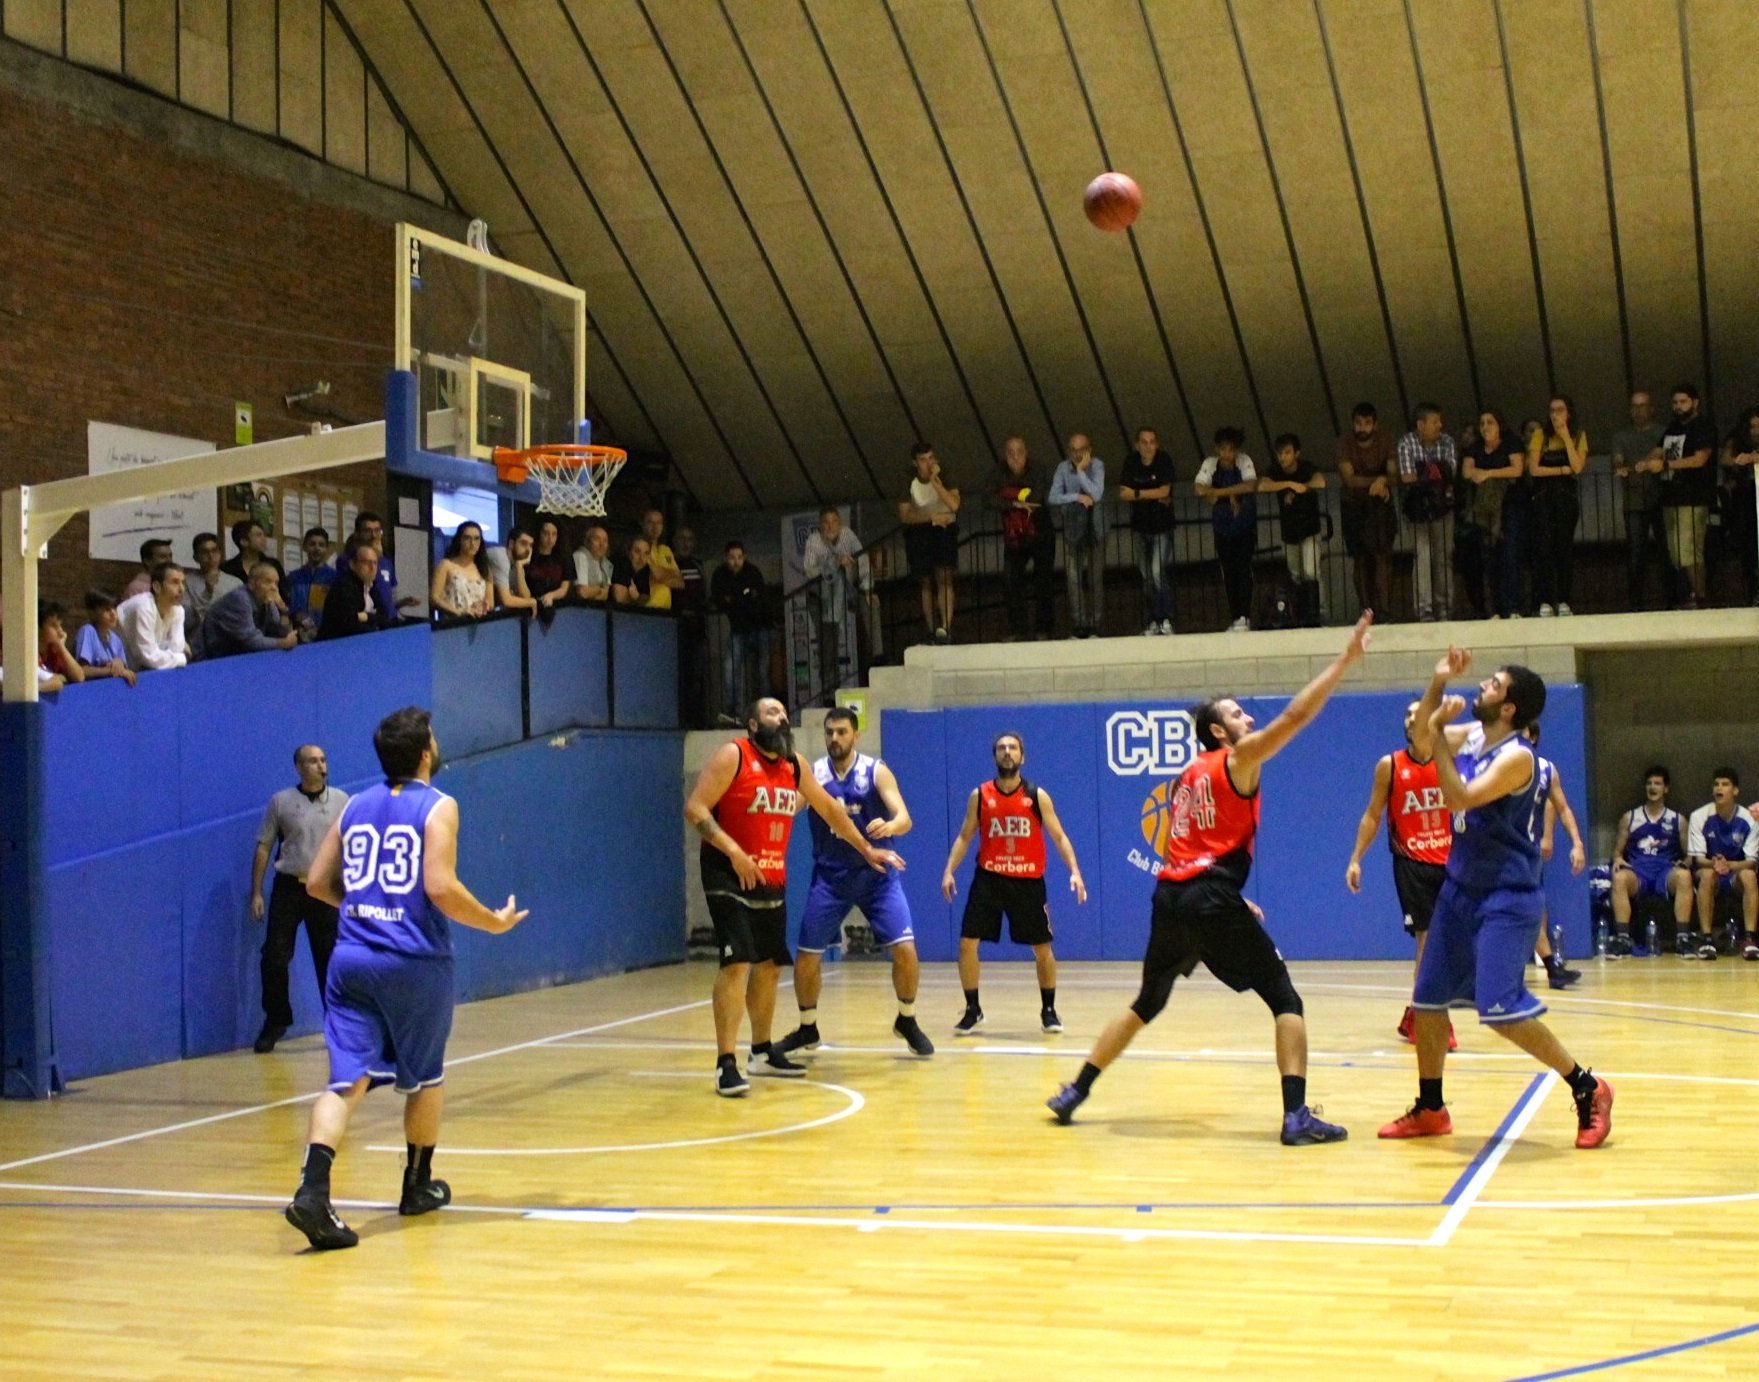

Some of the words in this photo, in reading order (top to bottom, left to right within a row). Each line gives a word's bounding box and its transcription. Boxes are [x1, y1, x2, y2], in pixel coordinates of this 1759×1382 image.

[747, 786, 798, 816] AEB
[1171, 775, 1216, 839] 24
[988, 816, 1032, 838] AEB
[343, 823, 421, 895] 93
[985, 860, 1036, 873] Corbera
[1127, 848, 1150, 871] Club
[357, 903, 404, 922] RIPOLLET
